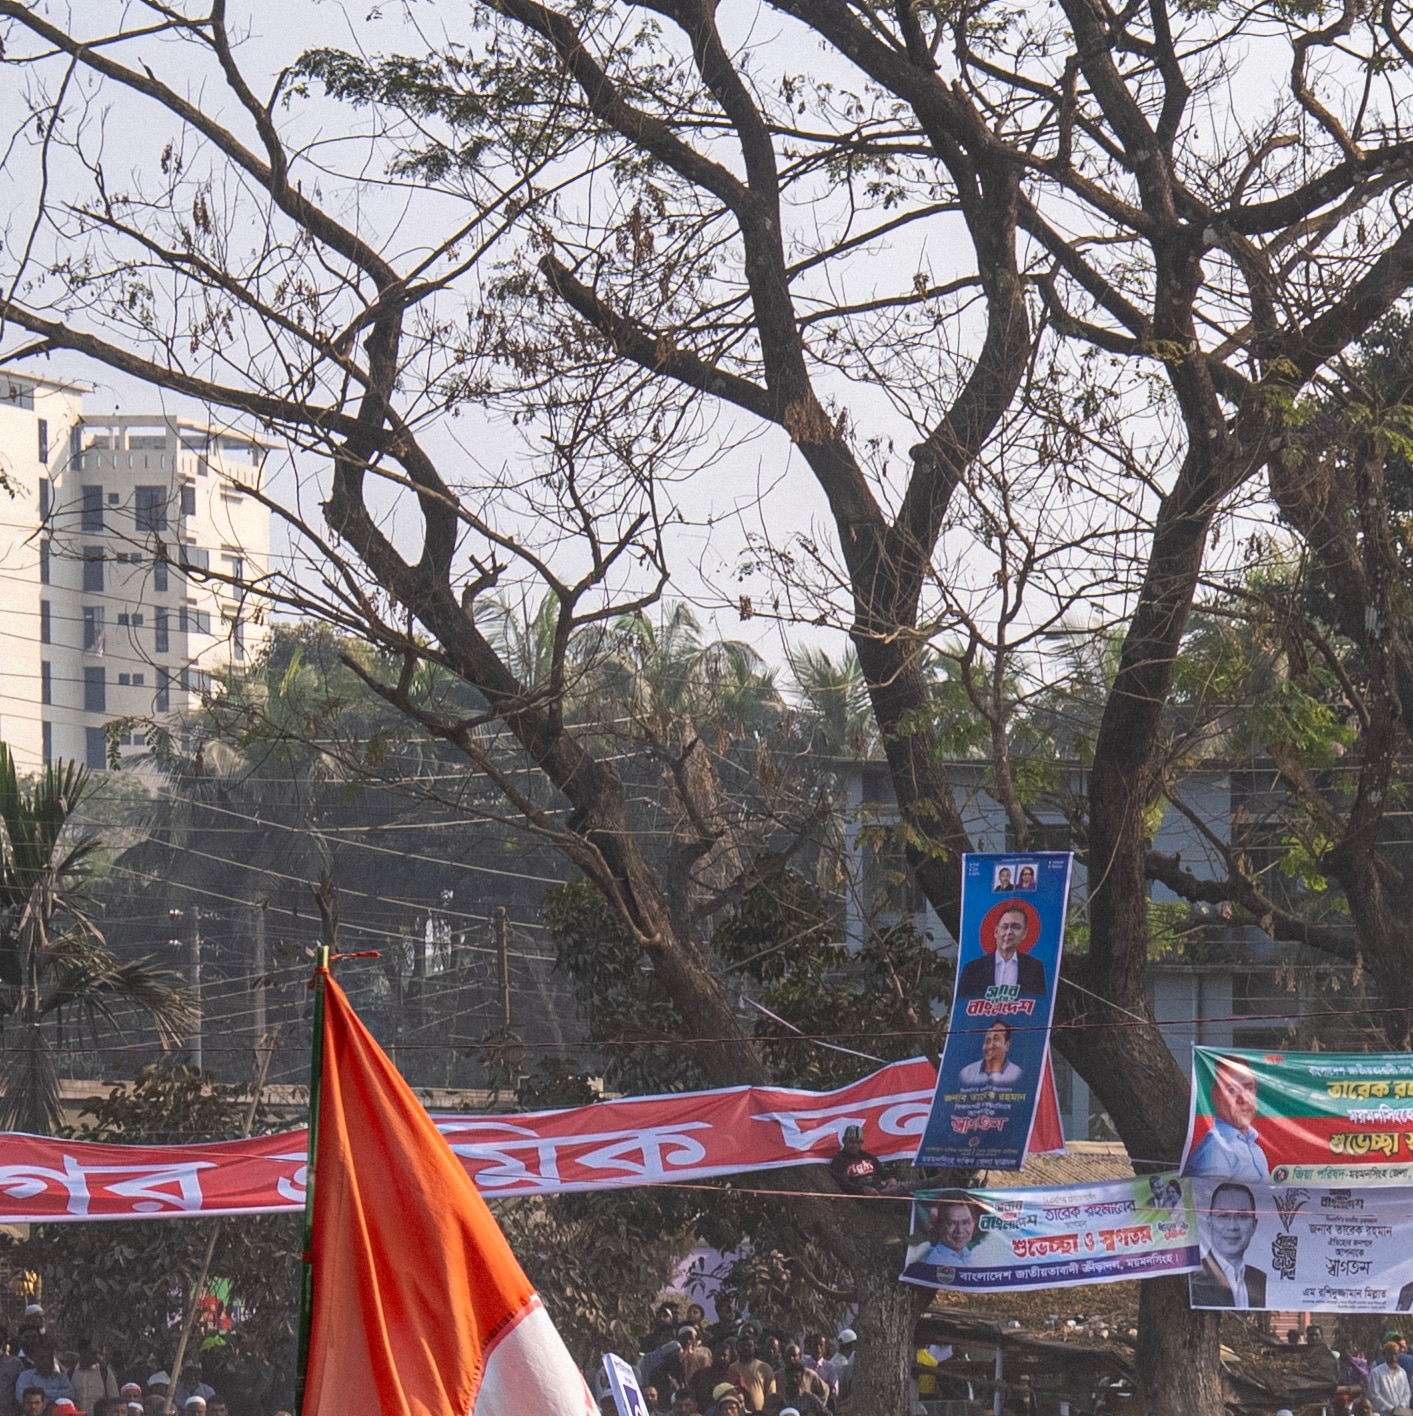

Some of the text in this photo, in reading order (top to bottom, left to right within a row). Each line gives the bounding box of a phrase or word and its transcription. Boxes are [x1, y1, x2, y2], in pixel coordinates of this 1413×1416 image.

[1326, 1079, 1391, 1101] তারেক
[1329, 1130, 1401, 1158] শুভেচ্ছা
[1044, 1199, 1136, 1222] তারেক রহমানের
[1309, 1223, 1393, 1238] জনাব তারেক রহমান
[1012, 1232, 1079, 1258] শুভেচ্ছা
[959, 1268, 1011, 1283] বাংলাদেশ
[1015, 1264, 1079, 1281] জাতীয়তাবাদী
[1326, 1256, 1374, 1279] স্বাগতম
